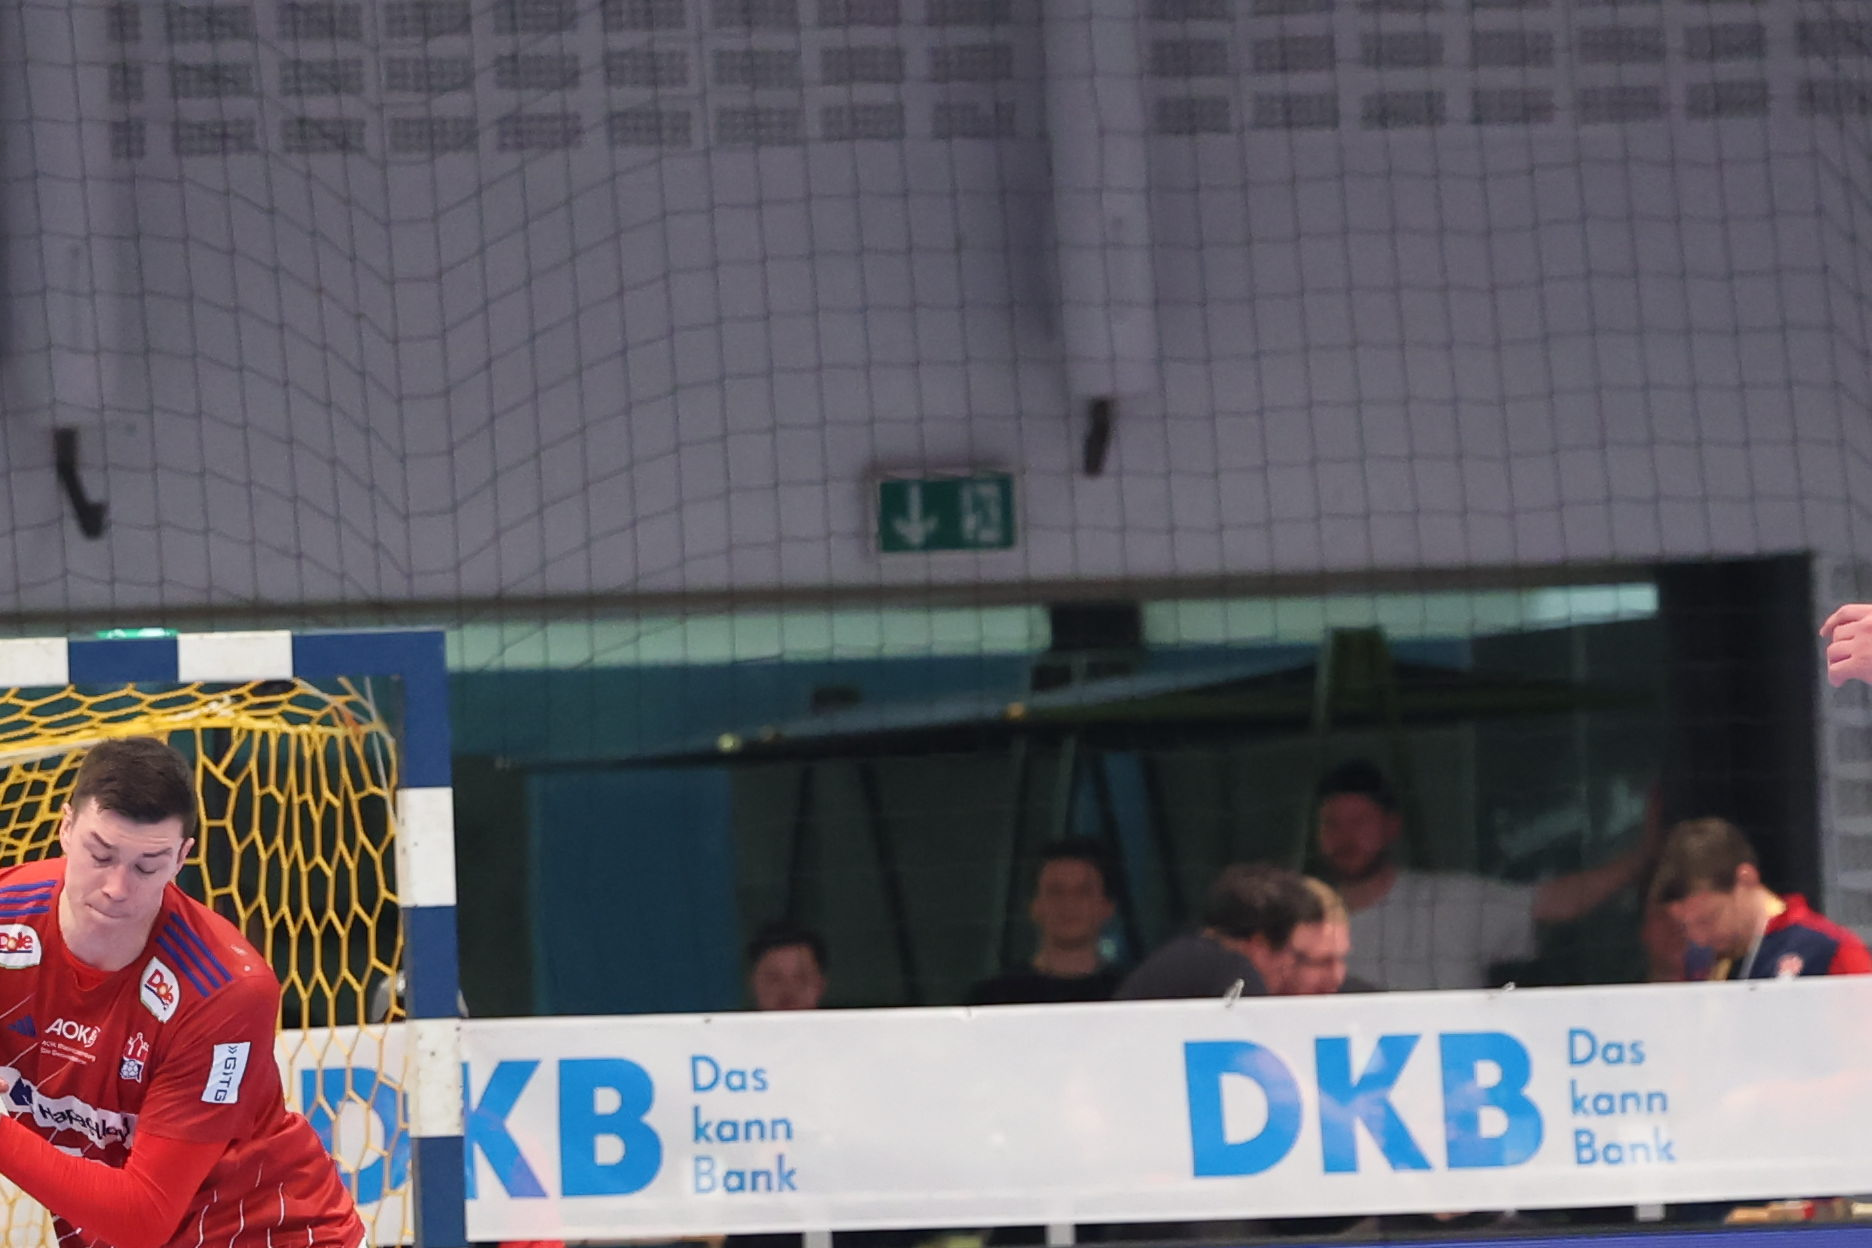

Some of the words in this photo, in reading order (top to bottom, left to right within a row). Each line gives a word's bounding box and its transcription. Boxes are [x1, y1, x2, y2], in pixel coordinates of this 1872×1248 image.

[44, 1017, 91, 1044] AOK
[1568, 1028, 1646, 1067] Das
[214, 1057, 237, 1102] GITG
[690, 1055, 769, 1093] Das
[1183, 1031, 1545, 1178] DKB
[1571, 1079, 1669, 1117] kann
[301, 1057, 664, 1205] DKB
[693, 1105, 794, 1144] kann
[1574, 1126, 1677, 1166] Bank
[693, 1154, 797, 1194] Bank
